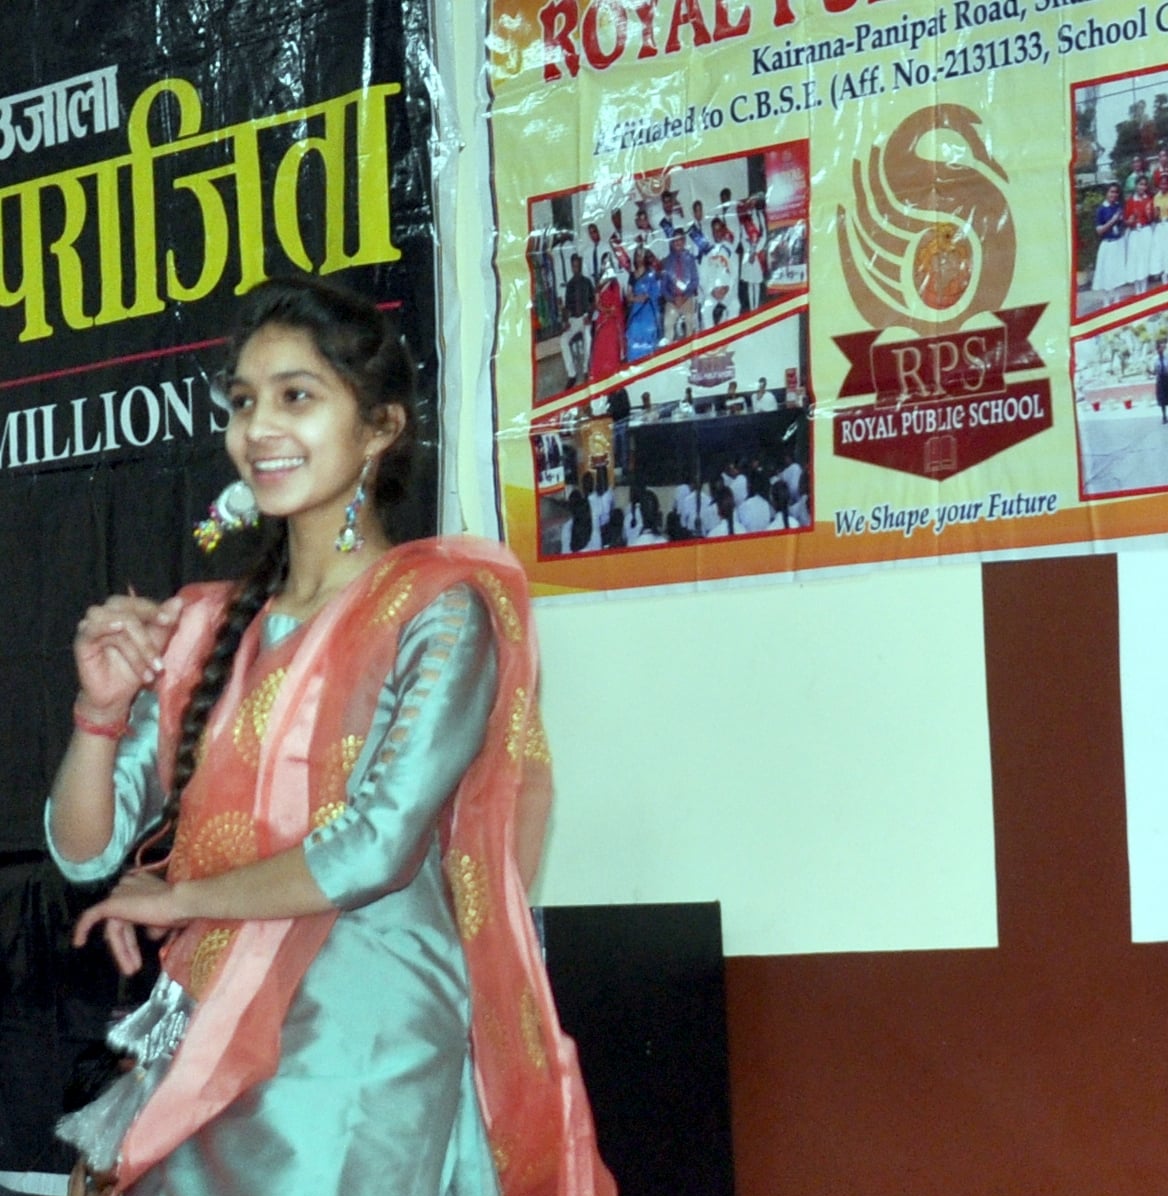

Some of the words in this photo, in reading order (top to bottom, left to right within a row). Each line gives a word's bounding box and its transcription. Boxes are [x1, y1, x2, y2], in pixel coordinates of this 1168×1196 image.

[751, 8, 947, 76] Kairana-Panipat
[954, 0, 1026, 30] Road,
[593, 106, 695, 155] filiated
[702, 106, 723, 130] to
[730, 80, 822, 123] C.B.S.E.
[830, 65, 885, 110] (Aff.
[1058, 8, 1147, 55] School
[892, 336, 988, 399] RPS
[841, 412, 897, 444] ROYAL
[901, 408, 964, 434] PUBLIC
[968, 394, 1044, 426] SCHOOL
[835, 511, 865, 534] We
[870, 506, 930, 535] Shape
[935, 503, 982, 531] your
[988, 492, 1057, 519] Future
